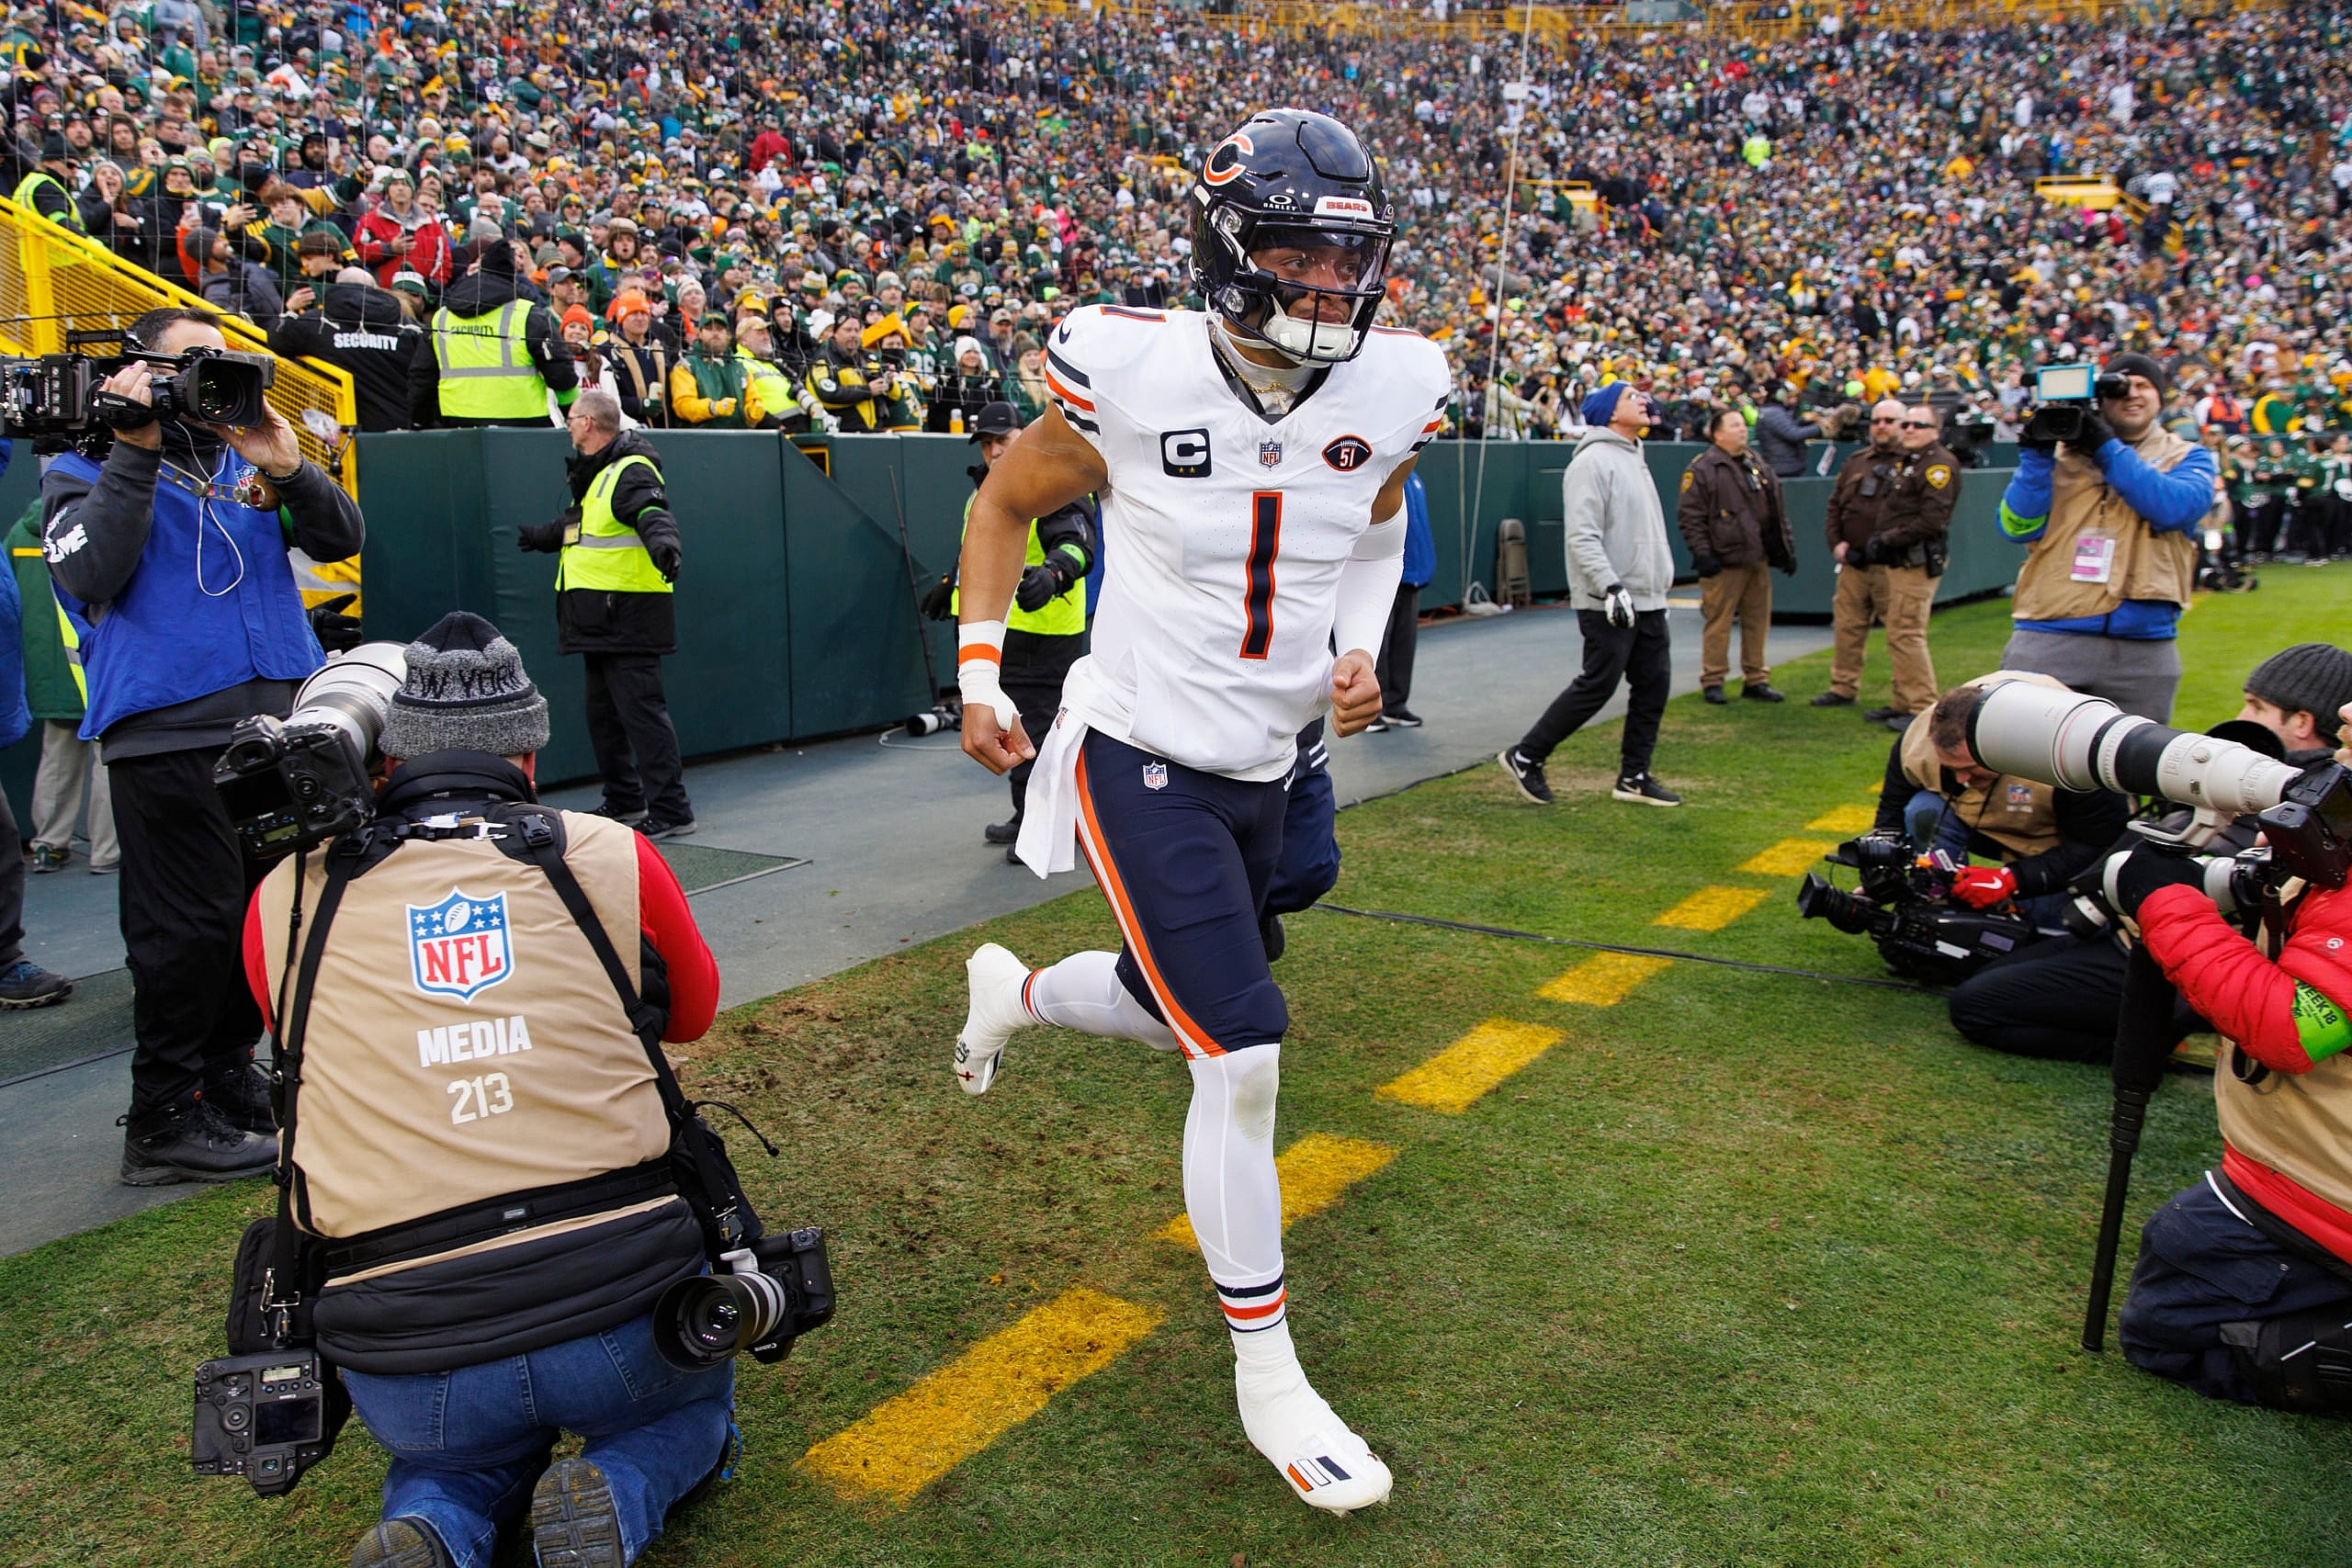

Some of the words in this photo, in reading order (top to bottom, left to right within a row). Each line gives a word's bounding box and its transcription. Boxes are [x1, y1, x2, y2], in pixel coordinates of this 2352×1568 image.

[1204, 133, 1255, 186] C
[1263, 202, 1298, 211] OAKLEY
[1327, 201, 1367, 212] BEARS
[334, 333, 398, 350] SECURITY
[450, 325, 493, 337] SECURITY
[1165, 433, 1207, 467] C
[1339, 446, 1356, 468] 51
[1239, 491, 1283, 660] 1
[404, 665, 449, 699] EW
[458, 661, 525, 699] YORK
[1148, 774, 1165, 786] NFL
[423, 934, 503, 986] NFL
[2298, 980, 2329, 1012] WEEK
[2323, 1009, 2338, 1026] 18
[416, 1015, 533, 1067] MEDIA
[447, 1072, 514, 1125] 213
